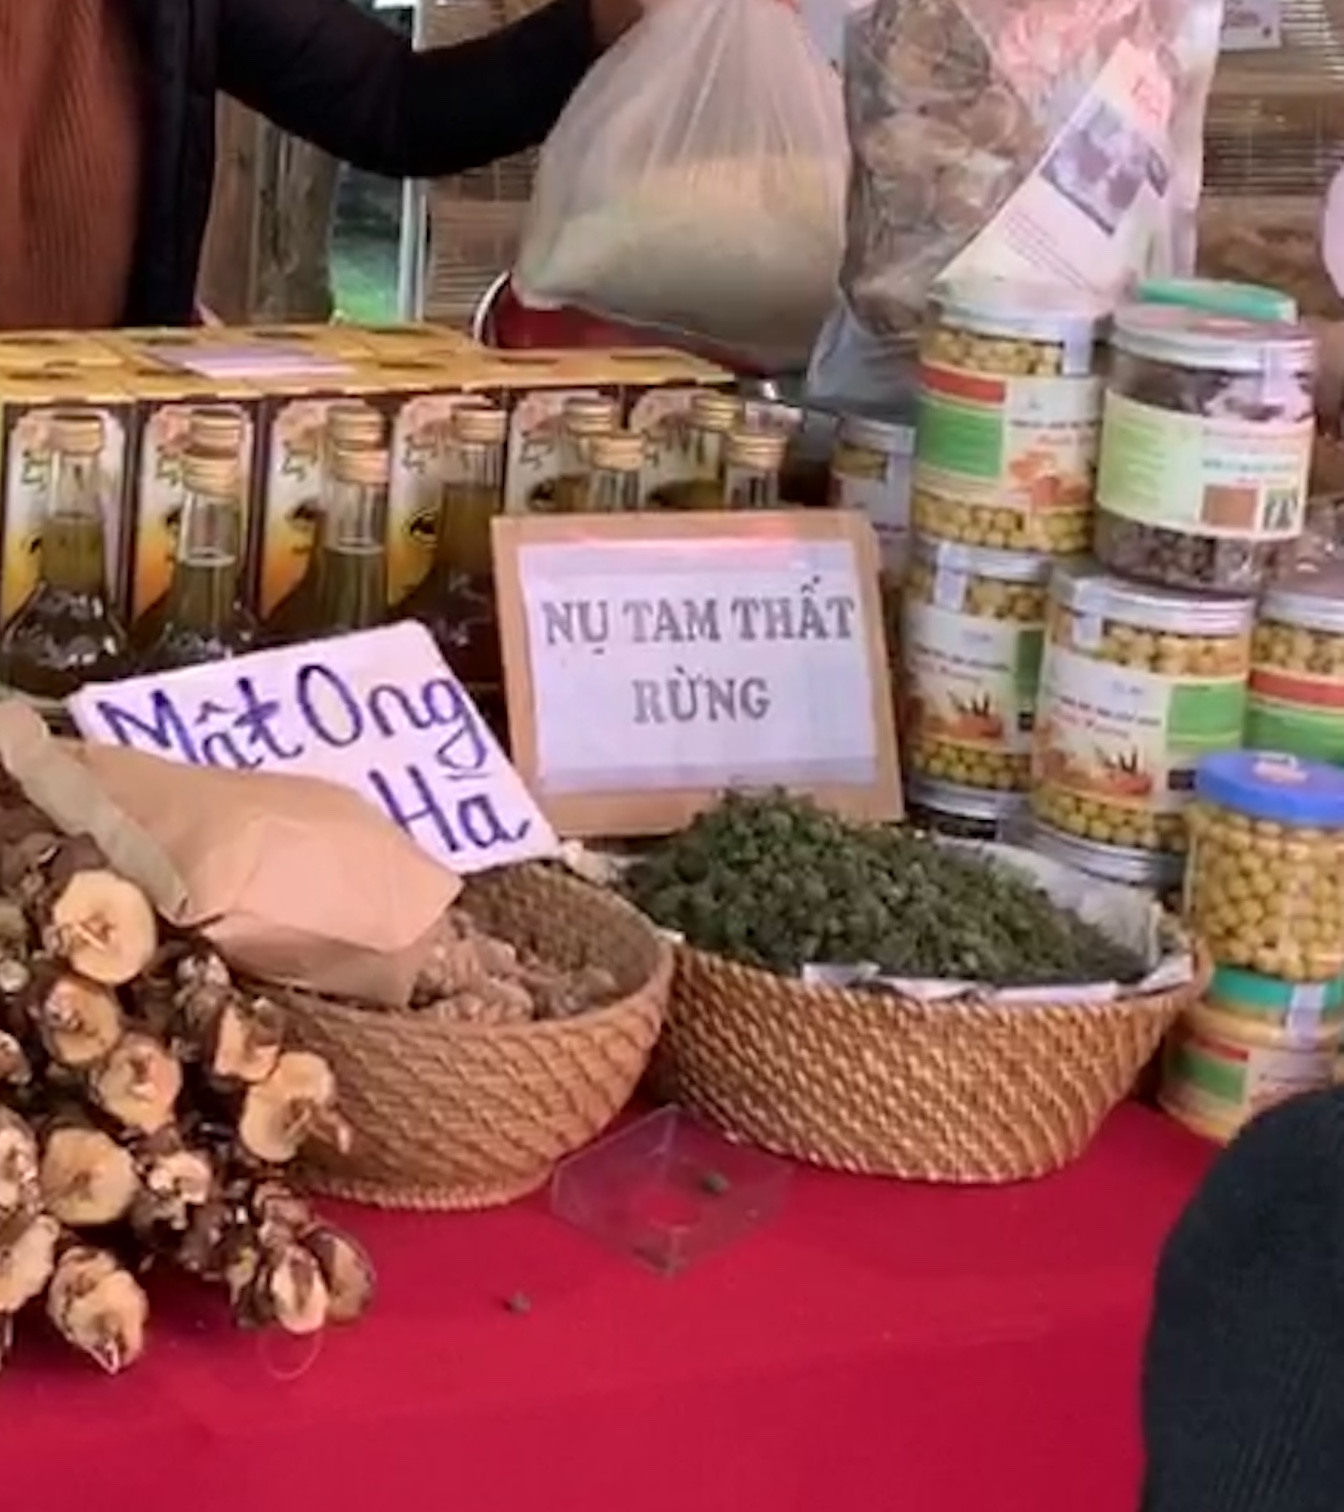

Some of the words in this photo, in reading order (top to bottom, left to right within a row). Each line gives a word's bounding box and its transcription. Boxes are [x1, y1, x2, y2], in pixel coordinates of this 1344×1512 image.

[541, 598, 609, 655] NỤ
[621, 597, 722, 644] TAM
[730, 573, 857, 642] THẤT
[296, 662, 488, 771] Ong
[631, 663, 771, 725] RỪNG
